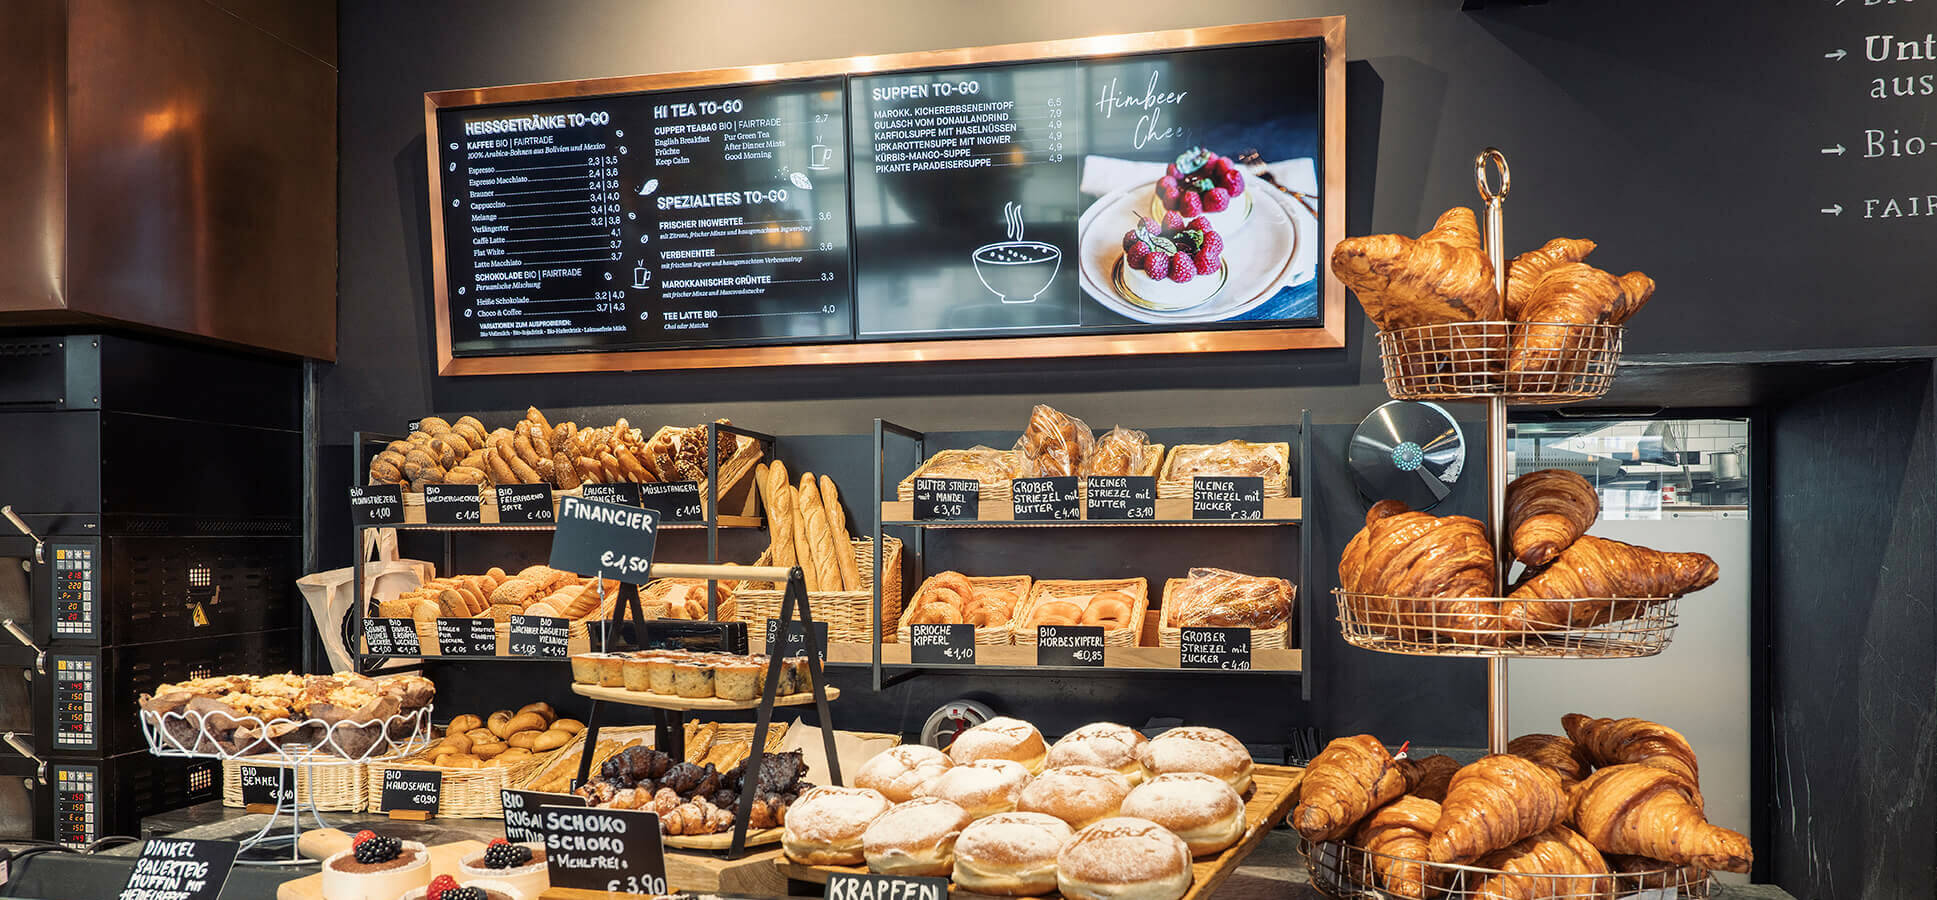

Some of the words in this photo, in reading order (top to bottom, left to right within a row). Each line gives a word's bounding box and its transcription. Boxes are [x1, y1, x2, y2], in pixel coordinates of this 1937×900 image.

[872, 85, 928, 100] SUPPEN
[932, 81, 980, 96] TO-GO
[1871, 75, 1933, 98] aus
[1096, 70, 1187, 118] Himbeer
[654, 105, 667, 119] HI
[671, 103, 696, 117] TEA
[699, 99, 743, 115] TO-GO
[874, 109, 912, 119] MAROKK.
[915, 101, 1013, 115] KICHERERBSENEINTOPF
[465, 114, 566, 136] HEISSGETRÄNKE
[567, 111, 610, 128] TO-GO
[655, 125, 685, 135] CUPPER
[686, 123, 717, 133] TEABAG
[719, 122, 732, 131] BIO
[738, 118, 781, 128] FAIRTRADE
[815, 114, 828, 124] 2,7
[874, 119, 913, 129] GULASCH
[915, 118, 934, 127] VOM
[937, 113, 1008, 125] DONAULANDRIND
[724, 134, 736, 142] Pur
[737, 132, 756, 140] Green
[875, 129, 936, 140] KARFIOLSUPPE
[938, 127, 954, 136] MIT
[956, 123, 1017, 134] HASELNÜSSEN
[467, 140, 494, 150] KAFFEE
[496, 138, 508, 148] BIO
[513, 136, 553, 146] FAIRTRADE
[655, 138, 678, 147] English
[680, 136, 709, 144] Breakfast
[725, 142, 741, 151] After
[742, 141, 765, 150] Dinner
[875, 139, 957, 151] URKAROTTENSUPPE
[960, 137, 975, 145] MIT
[977, 135, 1011, 144] INGWER
[655, 148, 680, 156] Früchte
[725, 153, 742, 161] Good
[743, 151, 771, 160] Morning
[876, 149, 971, 162] KÜRBIS-MANGO-SUPPE
[656, 158, 672, 167] Keep
[673, 156, 690, 164] Calm
[876, 163, 910, 173] PIKANTE
[913, 158, 991, 170] PARADEISERSUPPE
[468, 167, 495, 175] Espresso
[469, 179, 495, 187] Espresso
[497, 176, 528, 184] Macchiato
[657, 192, 741, 210] SPEZIALTEES
[744, 189, 787, 204] TO-GO
[659, 221, 696, 230] FRISCHER
[698, 218, 743, 227] INGWERTEE
[661, 249, 715, 259] VERBENENTEE
[475, 272, 523, 282] SCHOKOLADE
[524, 271, 537, 279] BIO
[542, 268, 582, 278] FAIRTRADE
[662, 278, 733, 289] MAROKKANISCHER
[735, 275, 771, 284] GRÜNTEE
[821, 273, 834, 281] 3,3
[663, 312, 678, 320] TEE
[679, 311, 702, 320] LATTE
[705, 310, 718, 319] BIO
[822, 305, 835, 314] 4,0
[917, 480, 946, 490] BUTTER
[1089, 479, 1127, 488] KLEINER
[1195, 481, 1234, 491] KLEINER
[351, 488, 363, 496] BIO
[498, 488, 512, 496] BIO
[584, 487, 615, 496] LAUGEN
[642, 485, 698, 495] MÜSLISTANGERL
[1089, 489, 1131, 498] STRIEZEL
[1136, 489, 1150, 499] mit
[1195, 492, 1241, 500] STRIEZEL
[1245, 490, 1260, 501] mit
[936, 493, 966, 503] MANDEL
[1015, 493, 1060, 503] STRIEZEL
[1015, 504, 1053, 513] BUTTER
[1089, 500, 1126, 508] BUTTER
[1195, 502, 1232, 511] ZUCKER
[564, 499, 653, 533] FINANCIER
[512, 616, 525, 624] BIO
[914, 626, 950, 636] BRIOCHE
[1040, 628, 1056, 637] BIO
[914, 636, 949, 646] KIPFERL
[1182, 644, 1226, 653] STRIEZEL
[1182, 654, 1219, 663] ZUCKER
[242, 768, 256, 776] BIO
[386, 770, 401, 779] BIO
[503, 791, 523, 807] BIO
[547, 812, 626, 833] SCHOKO
[144, 840, 196, 857] DINKEL
[548, 835, 624, 853] SCHOKO
[135, 858, 208, 878] SAUERTEIG
[128, 874, 181, 890] MUFFIN
[830, 877, 938, 900] KRAPFEN
